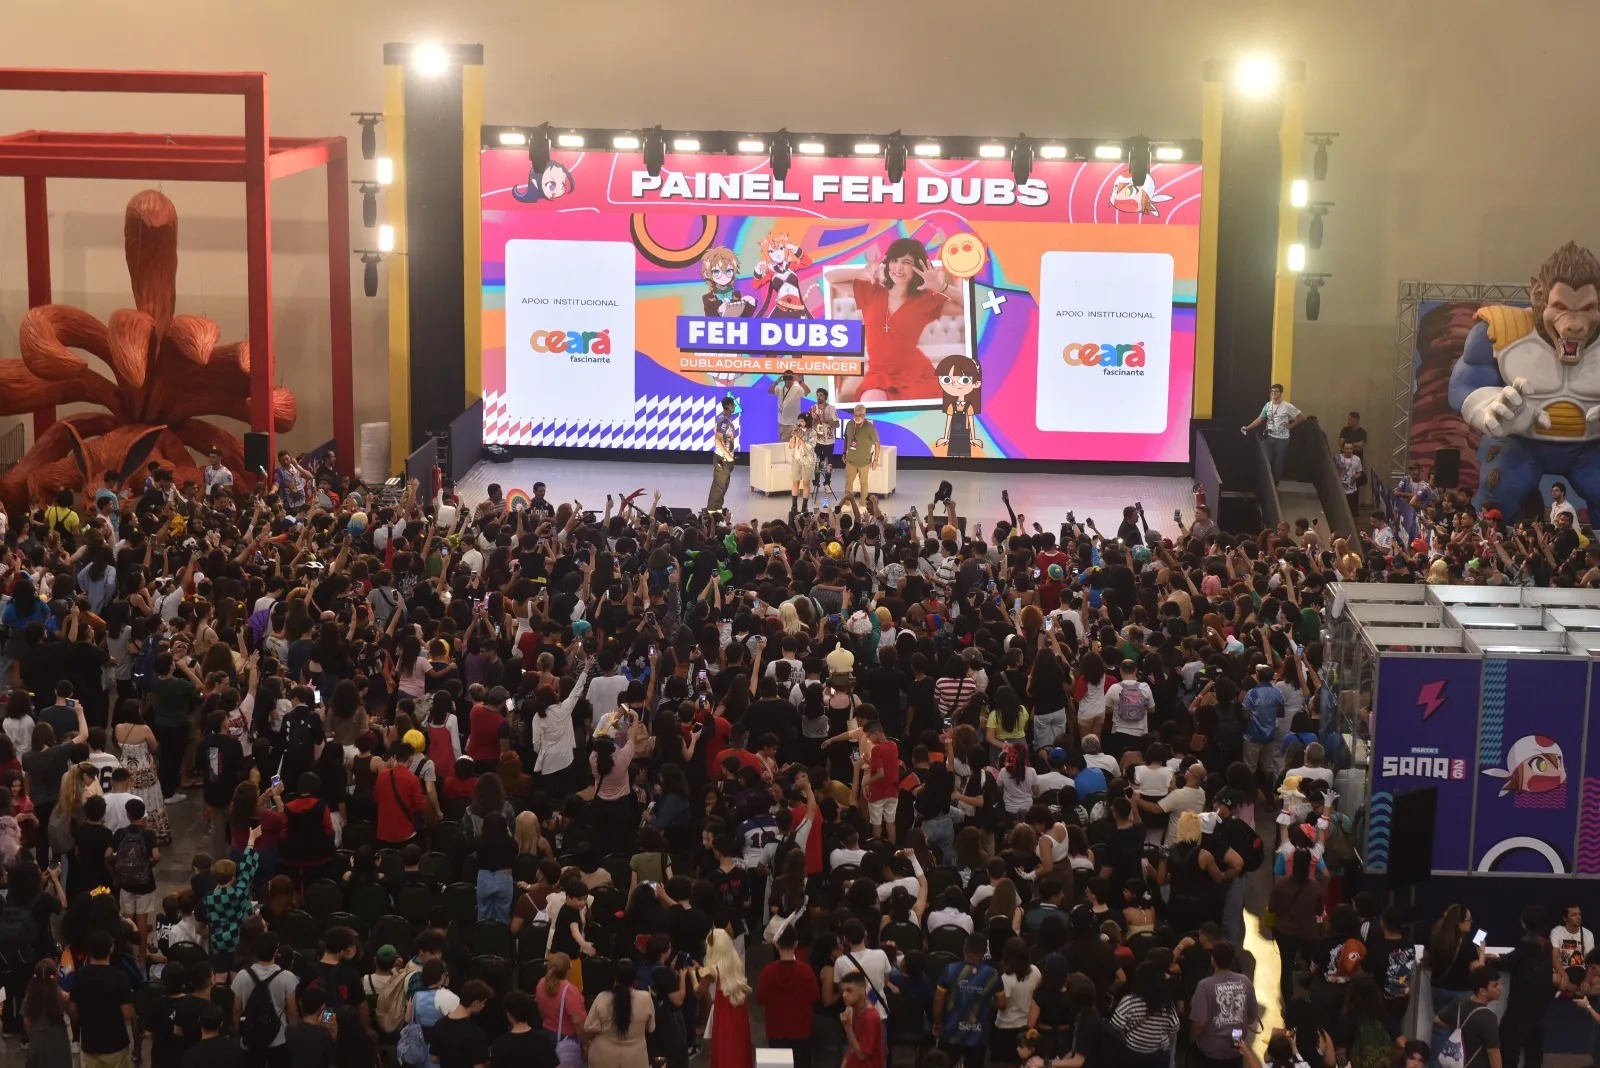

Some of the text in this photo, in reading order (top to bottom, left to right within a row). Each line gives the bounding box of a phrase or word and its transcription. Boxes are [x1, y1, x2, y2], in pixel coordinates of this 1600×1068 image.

[631, 171, 1050, 207] PAINEL FEH DUBS
[521, 297, 619, 307] APOIO INSTITUCIONAL
[1055, 310, 1155, 319] APOIO INSTITUCIONAL
[688, 320, 849, 348] FEH DUBS
[569, 355, 611, 363] fascinante
[680, 358, 858, 372] DUBLADORA E INFLUENCER
[1103, 368, 1145, 376] fascinante
[1382, 756, 1449, 780] SANA
